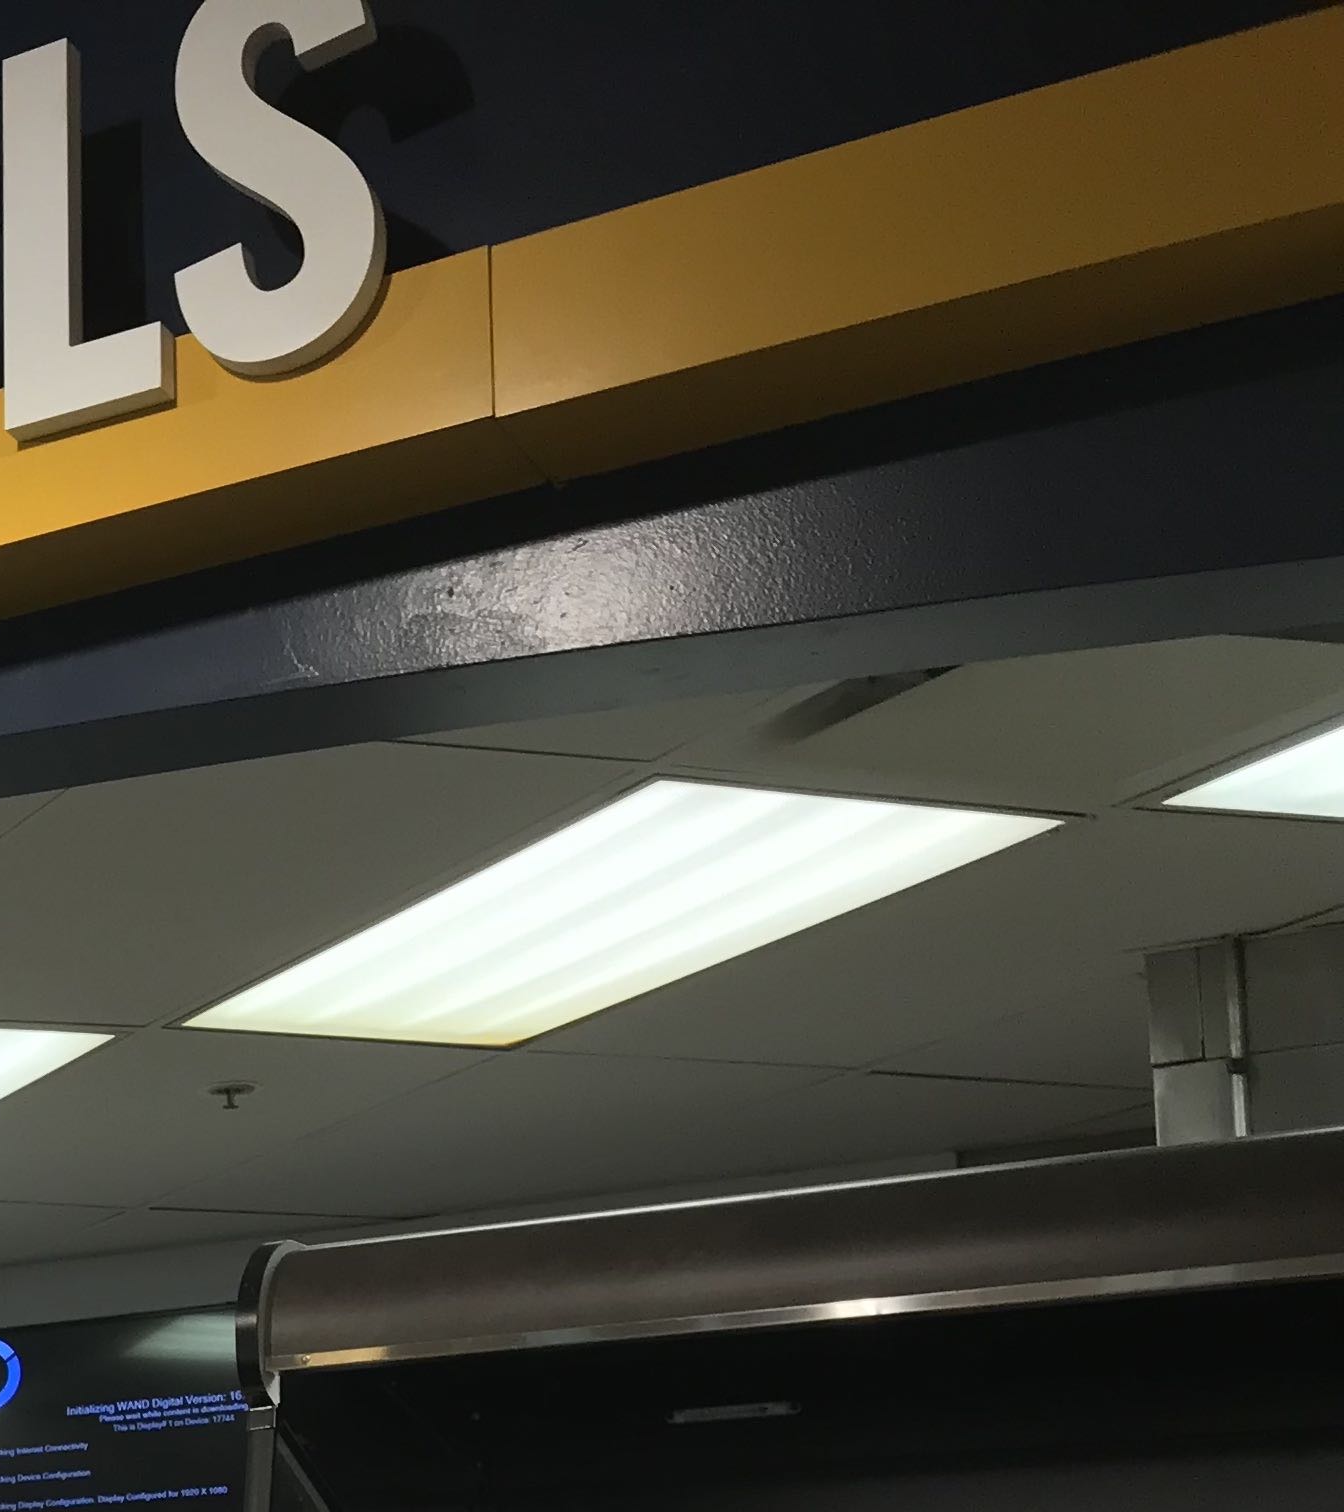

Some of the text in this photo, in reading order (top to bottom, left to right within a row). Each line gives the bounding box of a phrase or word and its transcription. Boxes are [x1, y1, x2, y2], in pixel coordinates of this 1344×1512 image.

[67, 1392, 226, 1417] Initializing WAND Digital Version:
[201, 1402, 248, 1414] downloading
[45, 1442, 89, 1453] Connectivity
[43, 1470, 91, 1480] Configuration
